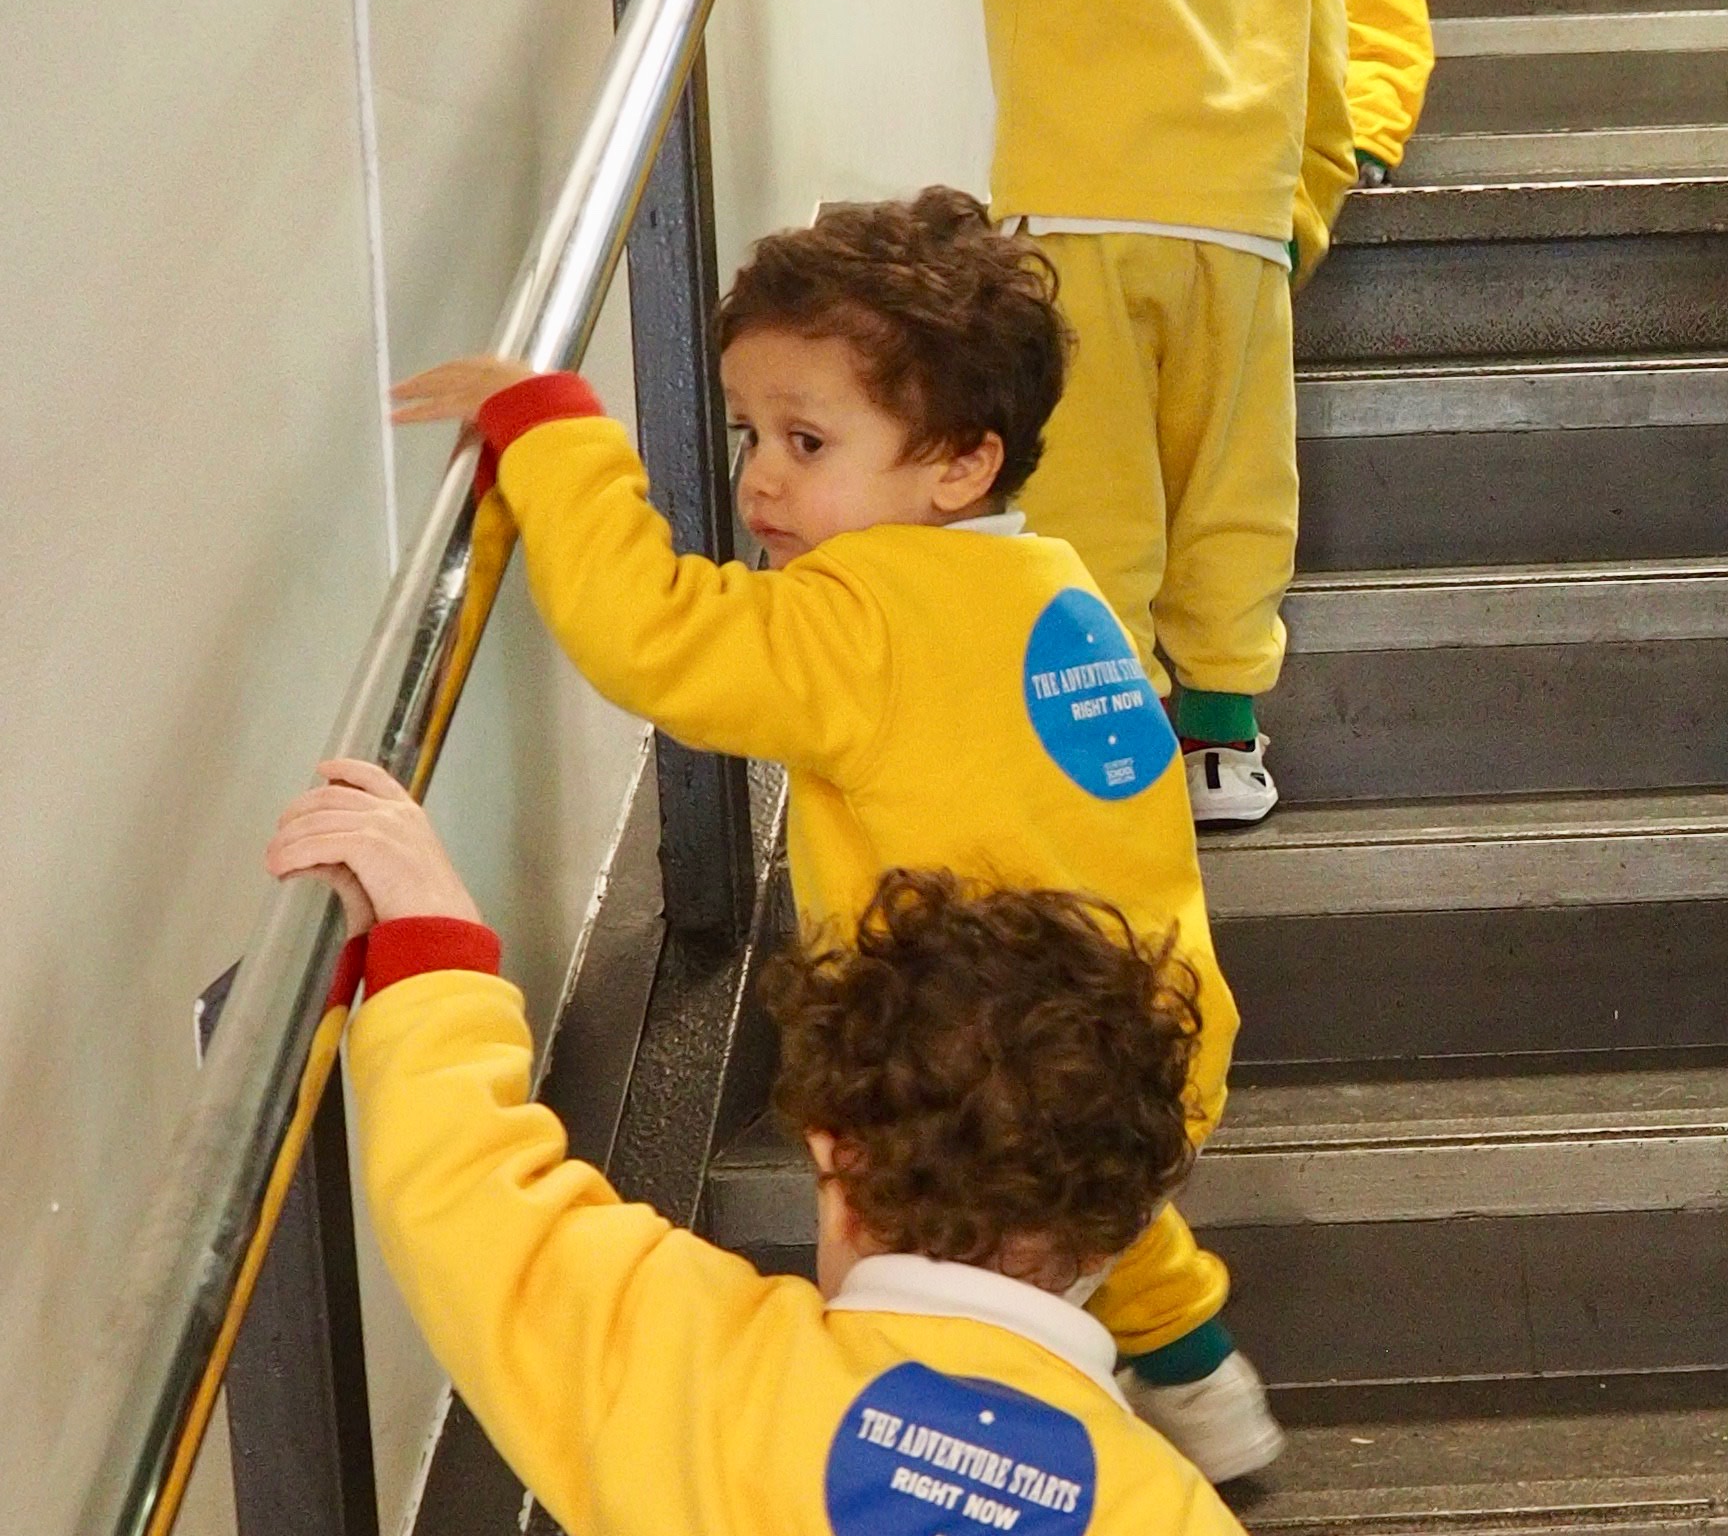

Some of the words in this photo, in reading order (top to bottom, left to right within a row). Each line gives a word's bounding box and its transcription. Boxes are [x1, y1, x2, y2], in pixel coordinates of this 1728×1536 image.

[1031, 671, 1060, 700] THE
[1059, 659, 1122, 693] ADVENTURE
[1071, 696, 1108, 721] RIGHT
[1111, 690, 1143, 712] NOW
[858, 1407, 903, 1449] THE
[898, 1424, 1014, 1490] ADVENTURE
[1008, 1463, 1082, 1514] STARTS
[890, 1466, 964, 1511] RIGHT
[962, 1493, 1021, 1531] NOW
